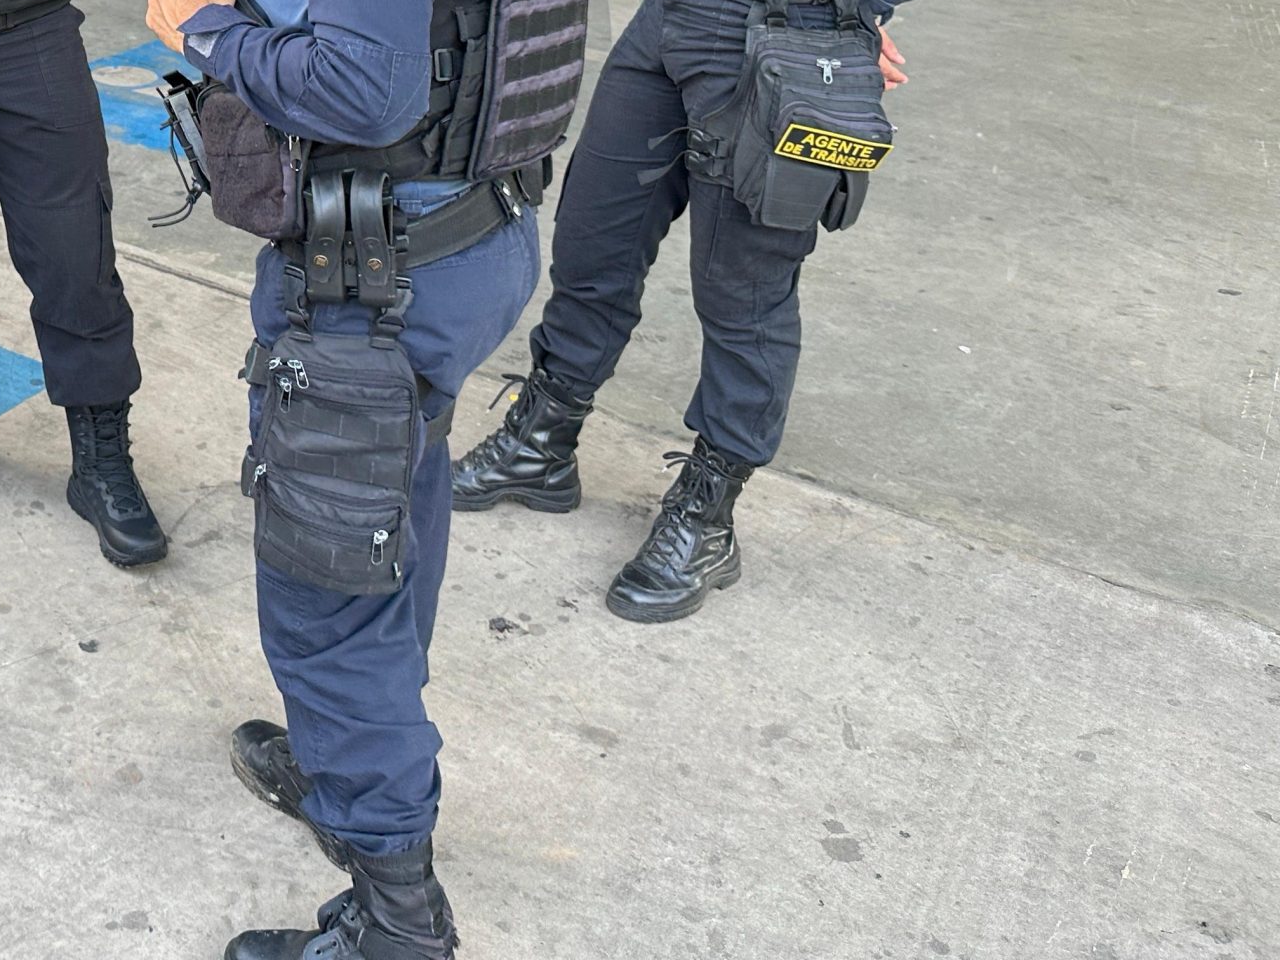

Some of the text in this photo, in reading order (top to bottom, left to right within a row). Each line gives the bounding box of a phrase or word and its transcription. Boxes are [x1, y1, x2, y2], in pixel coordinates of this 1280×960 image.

[783, 141, 876, 168] DE TRÂNSITO
[801, 132, 875, 158] AGENTE
